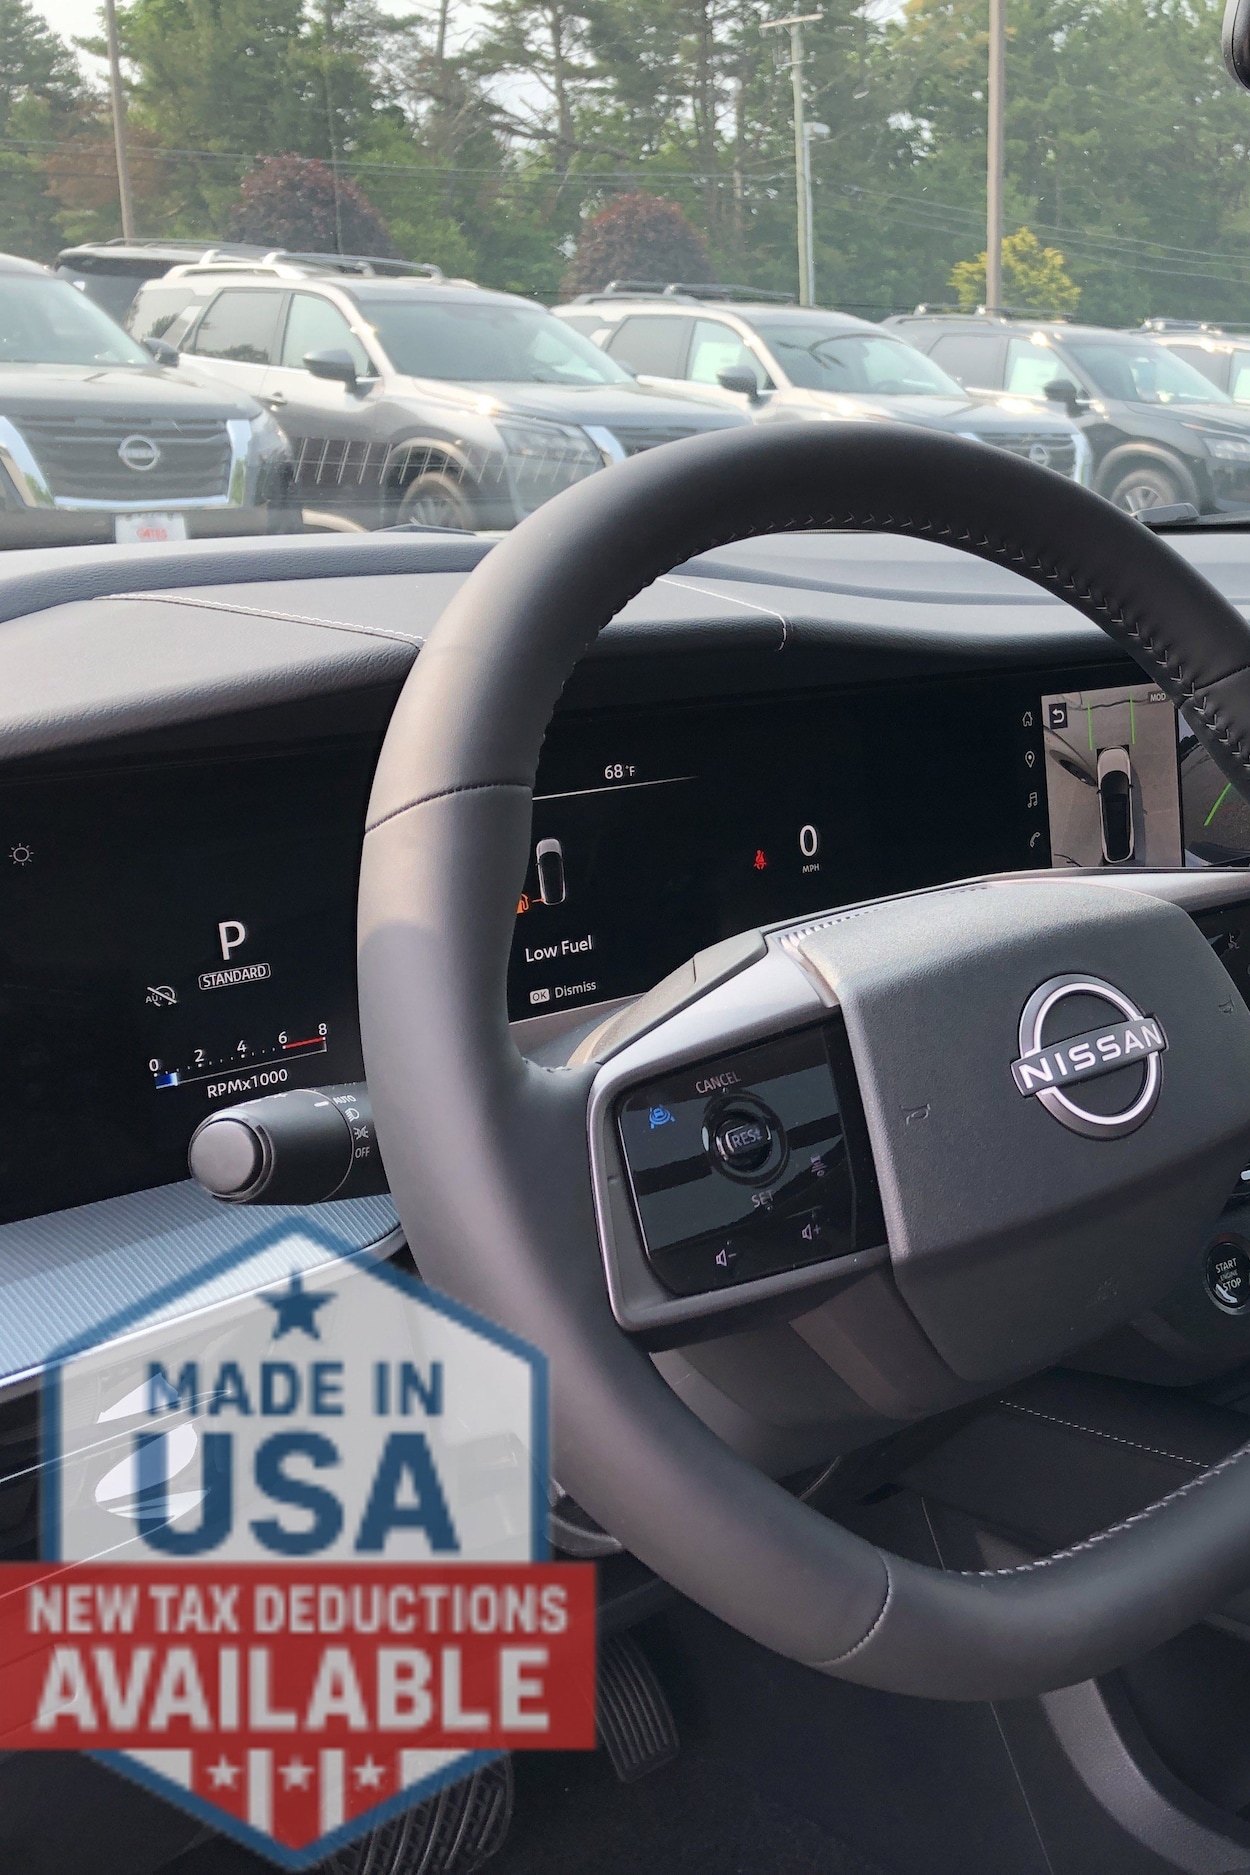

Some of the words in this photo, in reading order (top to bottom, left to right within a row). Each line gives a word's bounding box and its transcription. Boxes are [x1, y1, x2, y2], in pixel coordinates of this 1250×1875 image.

[1150, 692, 1167, 702] MOD
[800, 825, 818, 857] 0
[802, 863, 820, 874] MPH
[219, 921, 245, 960] P
[525, 944, 558, 963] Low
[561, 935, 593, 953] Fuel
[202, 965, 267, 988] STANDARD
[532, 990, 547, 1002] OK
[554, 980, 597, 999] Dismiss
[149, 1059, 160, 1072] 0
[194, 1050, 205, 1063] 2
[236, 1040, 247, 1053] 4
[278, 1031, 288, 1044] 6
[318, 1023, 328, 1036] 8
[1018, 1023, 1163, 1090] NISSAN
[207, 1068, 289, 1099] RPMx1000
[695, 1071, 741, 1094] CANCEL
[332, 1094, 357, 1105] AUTO
[355, 1146, 371, 1159] OFF
[751, 1189, 775, 1208] SET
[1215, 1257, 1238, 1274] START
[1222, 1277, 1242, 1292] STOP
